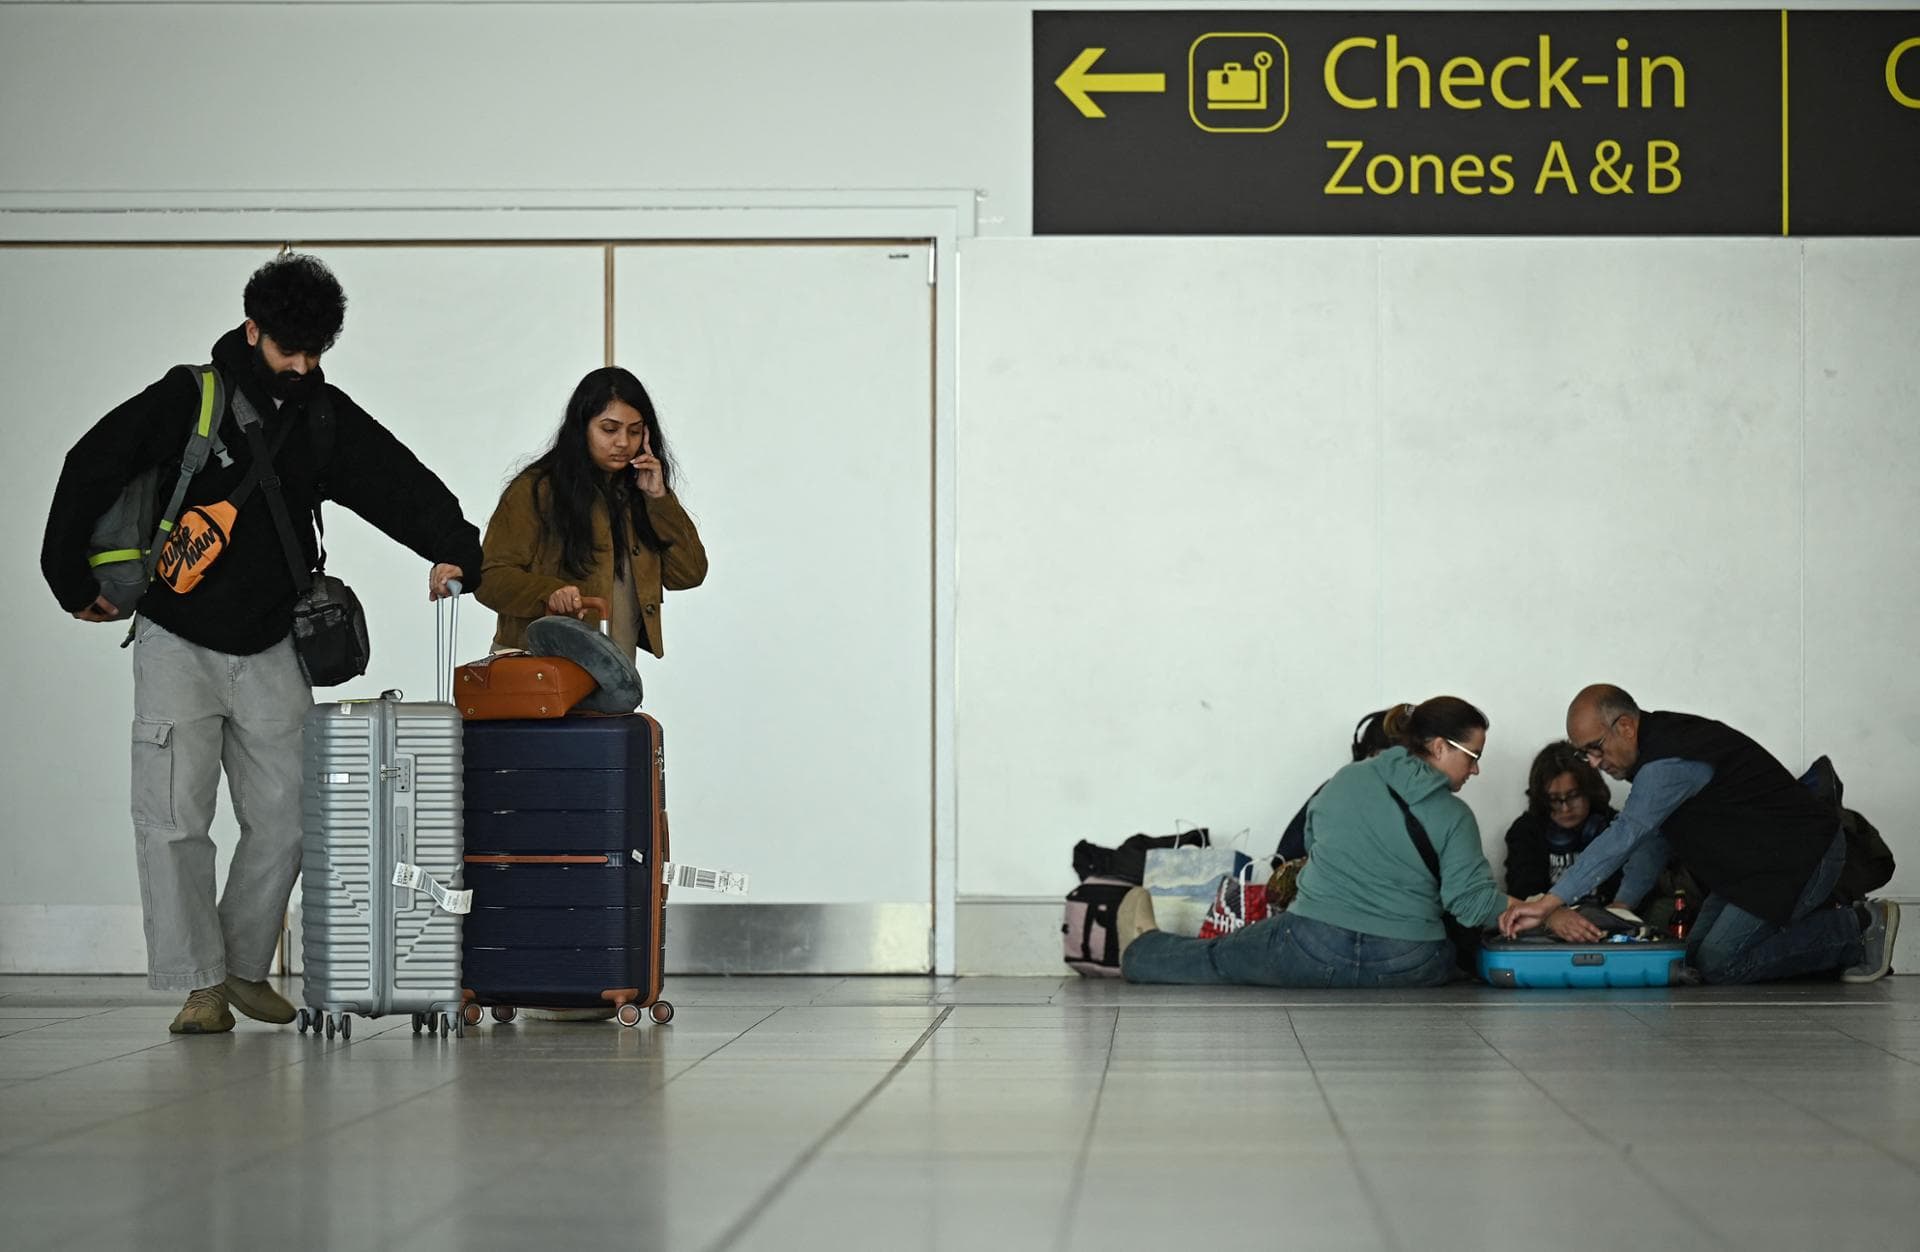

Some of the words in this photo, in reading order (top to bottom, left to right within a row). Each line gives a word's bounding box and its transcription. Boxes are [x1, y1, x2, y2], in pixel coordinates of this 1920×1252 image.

[1323, 33, 1687, 111] Check-in
[1323, 140, 1517, 196] Zones
[1534, 140, 1579, 195] A
[1589, 139, 1636, 196] &
[1647, 140, 1683, 195] B
[182, 527, 216, 571] MAN
